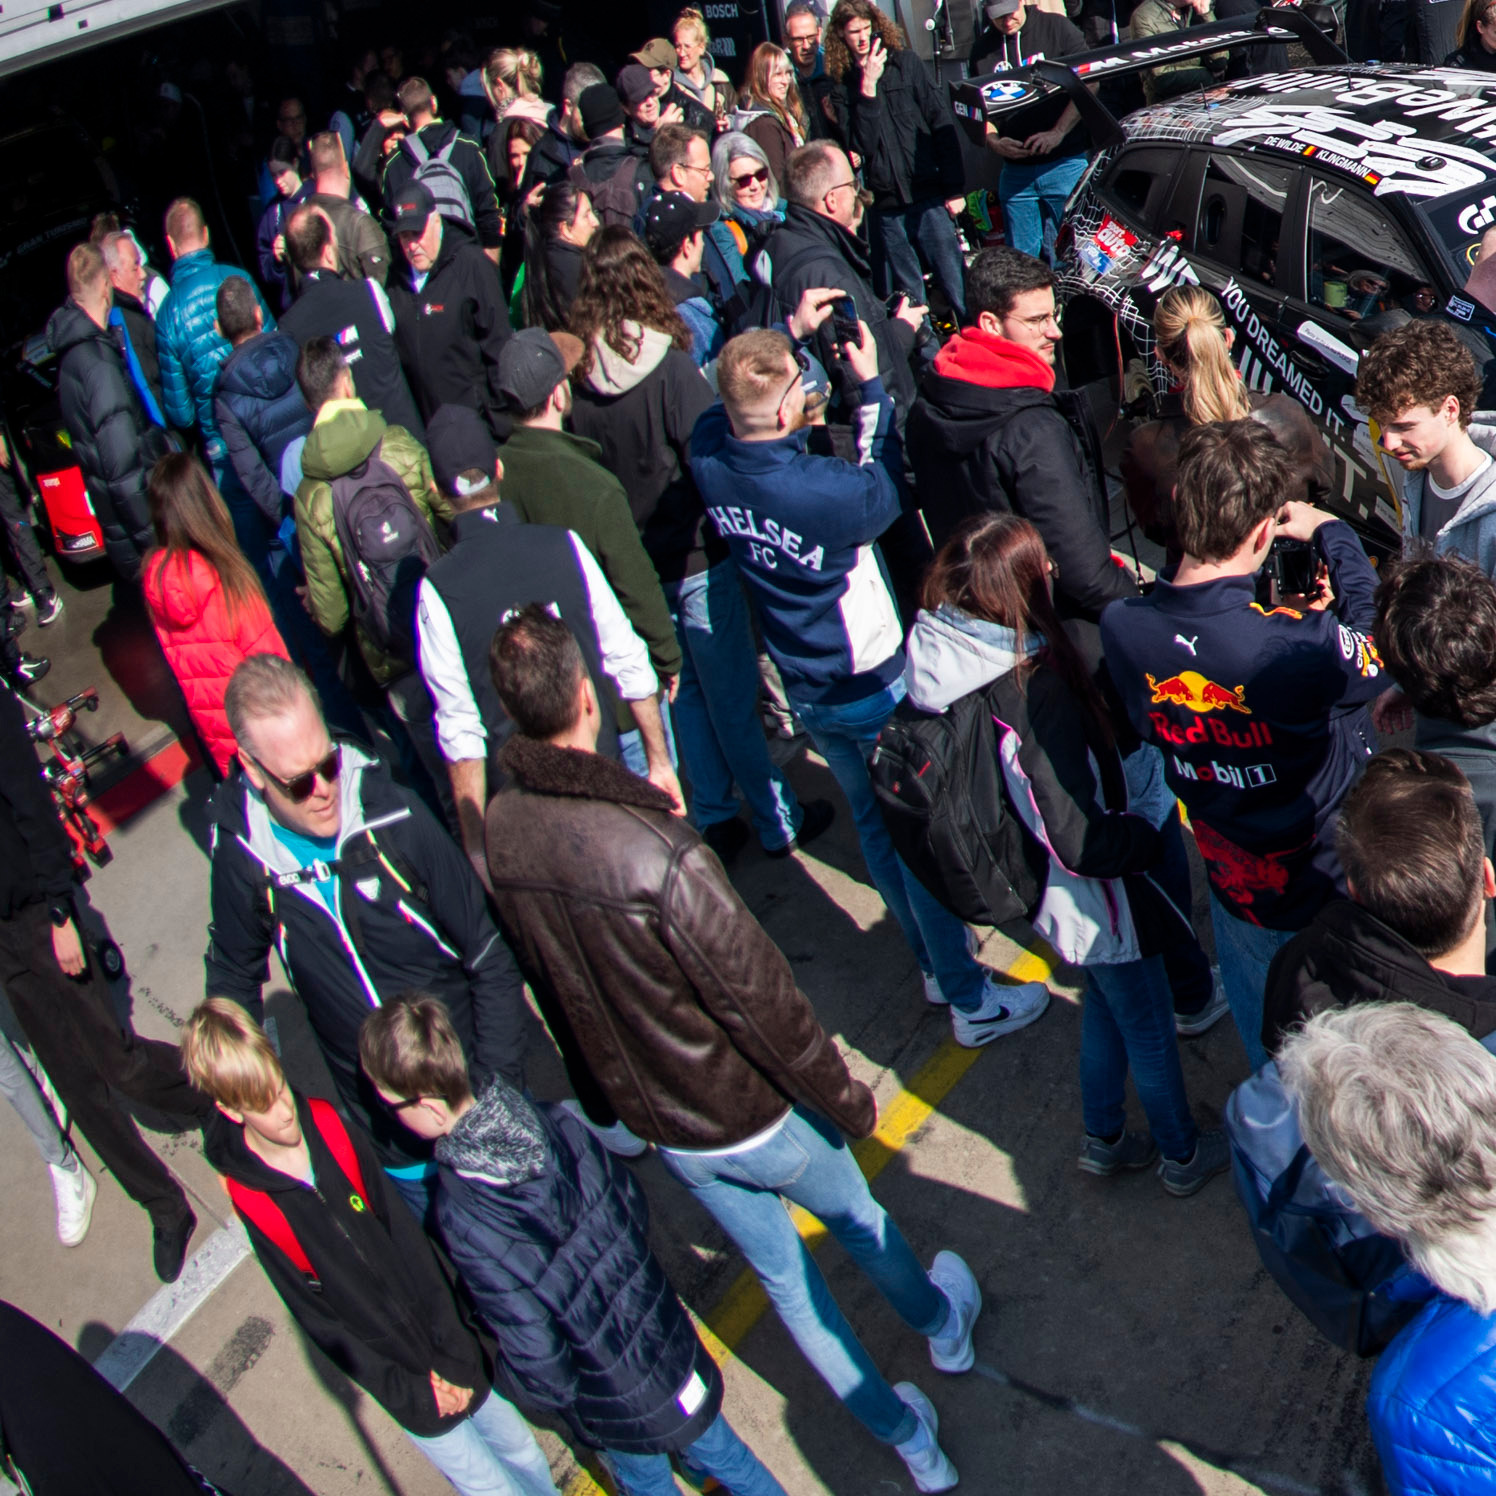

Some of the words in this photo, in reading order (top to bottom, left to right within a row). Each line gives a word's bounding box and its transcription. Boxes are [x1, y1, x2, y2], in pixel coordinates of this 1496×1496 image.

[705, 3, 739, 19] BOSCH
[1264, 135, 1276, 147] DE
[1276, 137, 1306, 154] WILDE
[1315, 149, 1370, 178] KLINGMANN
[1097, 228, 1131, 257] auto
[1220, 276, 1250, 323] YOU
[1246, 314, 1324, 416] DREAMED
[1325, 406, 1347, 442] IT.
[707, 505, 825, 571] HELSEA
[748, 541, 778, 569] FC
[1148, 711, 1209, 745] Red
[1208, 717, 1274, 748] Bull
[1172, 754, 1246, 789] Mobil
